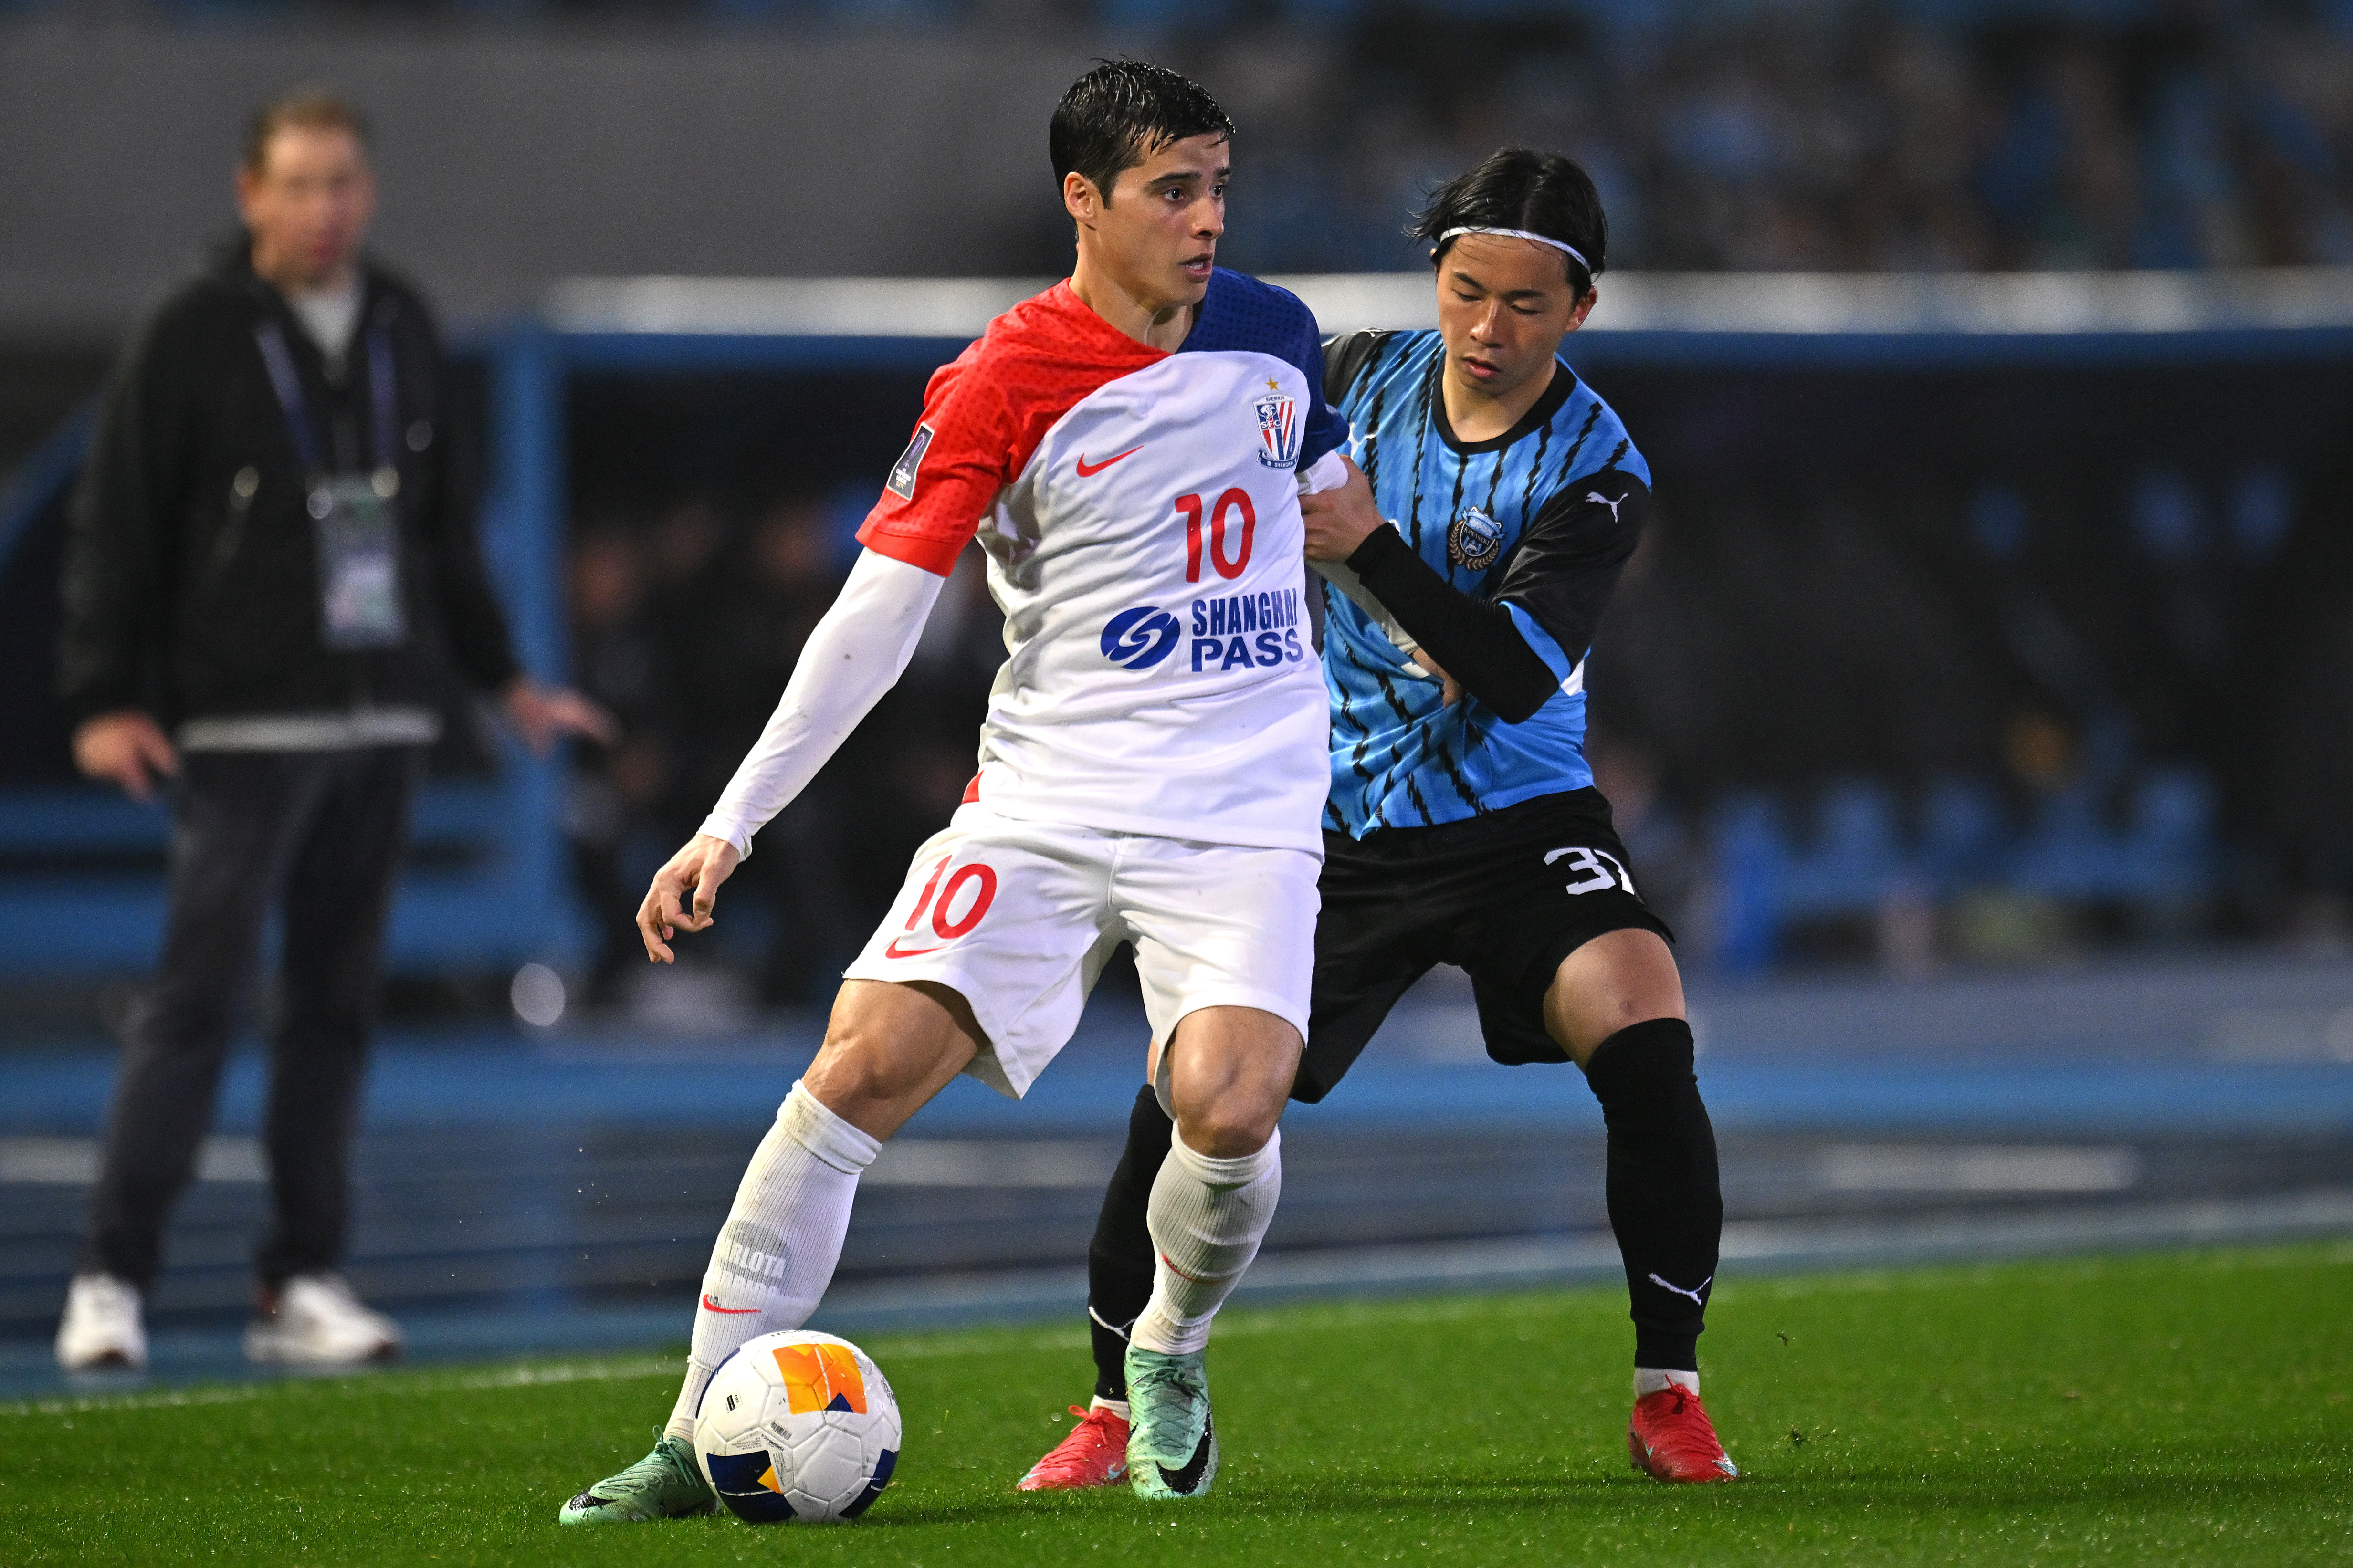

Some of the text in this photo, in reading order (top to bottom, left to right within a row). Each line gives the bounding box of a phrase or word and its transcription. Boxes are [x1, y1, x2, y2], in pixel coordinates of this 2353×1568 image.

[1261, 419, 1281, 429] SFC
[1175, 487, 1256, 583] 10
[1463, 526, 1490, 546] KAWASAKI
[1192, 588, 1297, 637] SHANGHAI
[1191, 628, 1303, 672] PASS
[904, 854, 997, 940] 10
